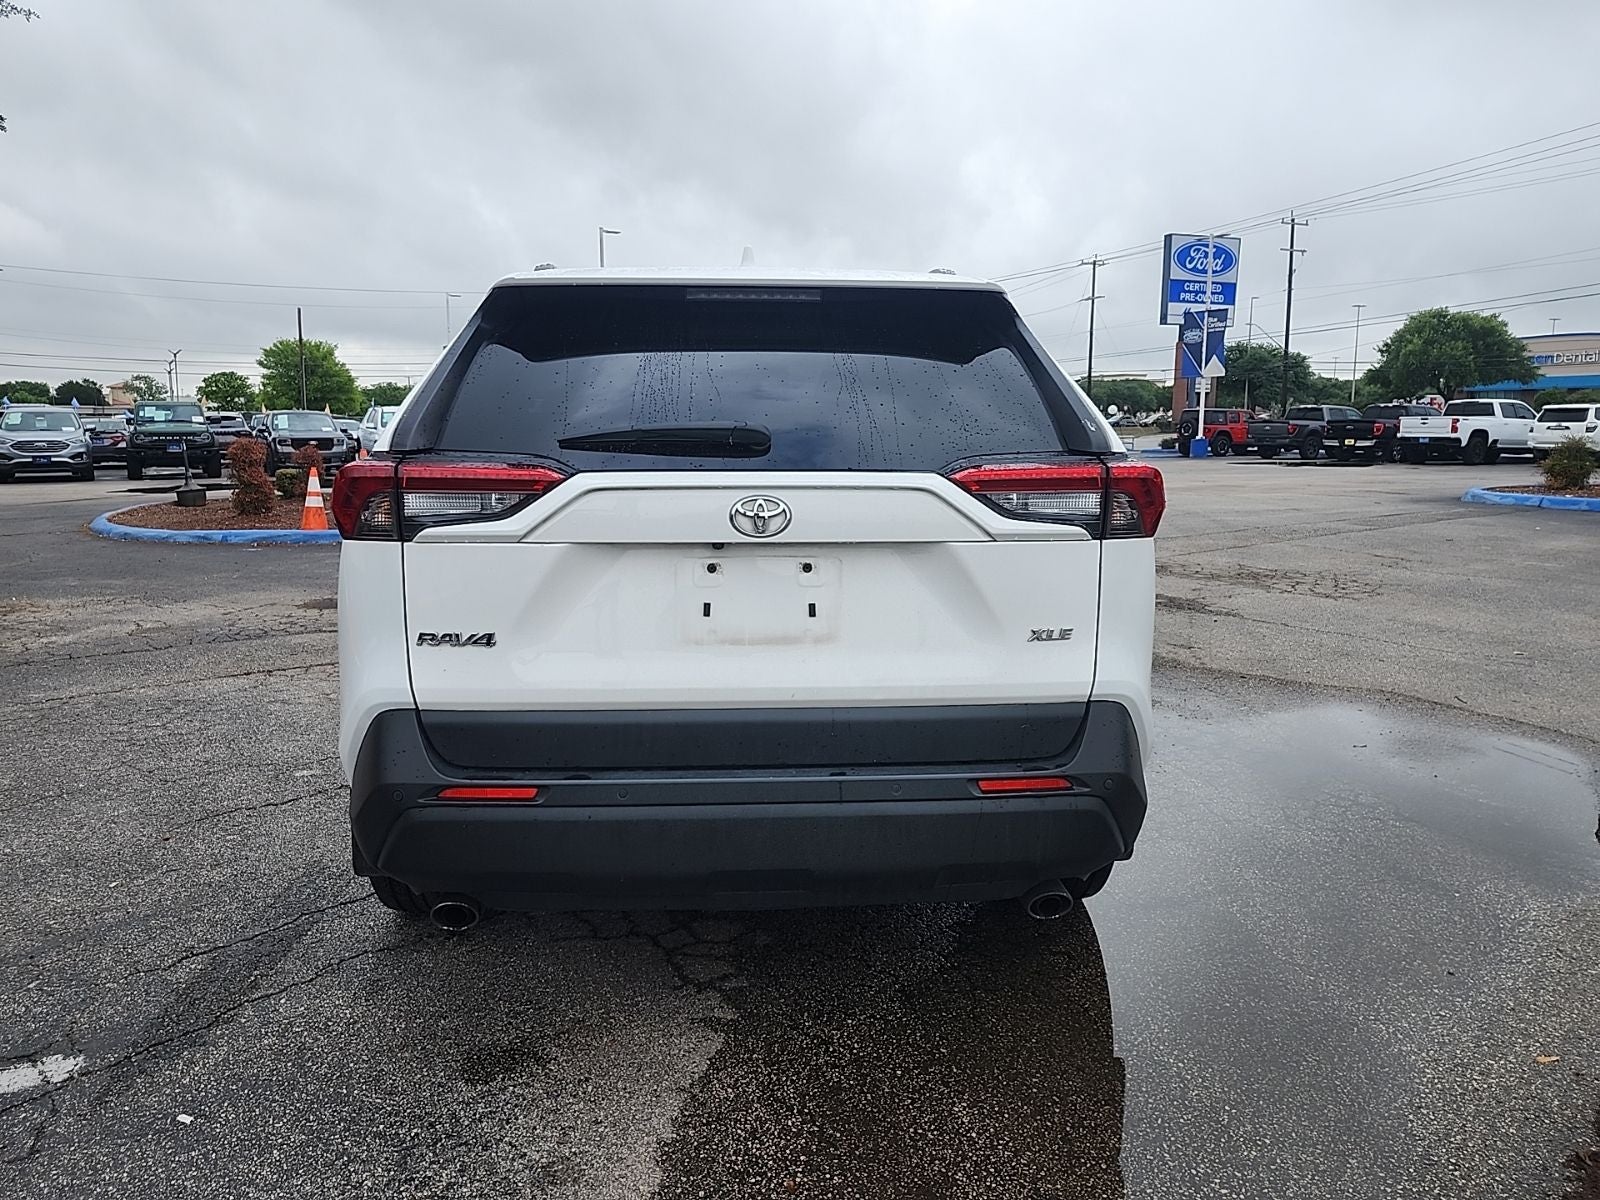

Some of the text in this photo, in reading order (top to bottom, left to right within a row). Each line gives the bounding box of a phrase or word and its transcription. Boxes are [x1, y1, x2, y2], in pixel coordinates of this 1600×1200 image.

[1184, 282, 1222, 292] CERTIED
[416, 632, 497, 648] RAV4
[1027, 628, 1074, 642] XLE
